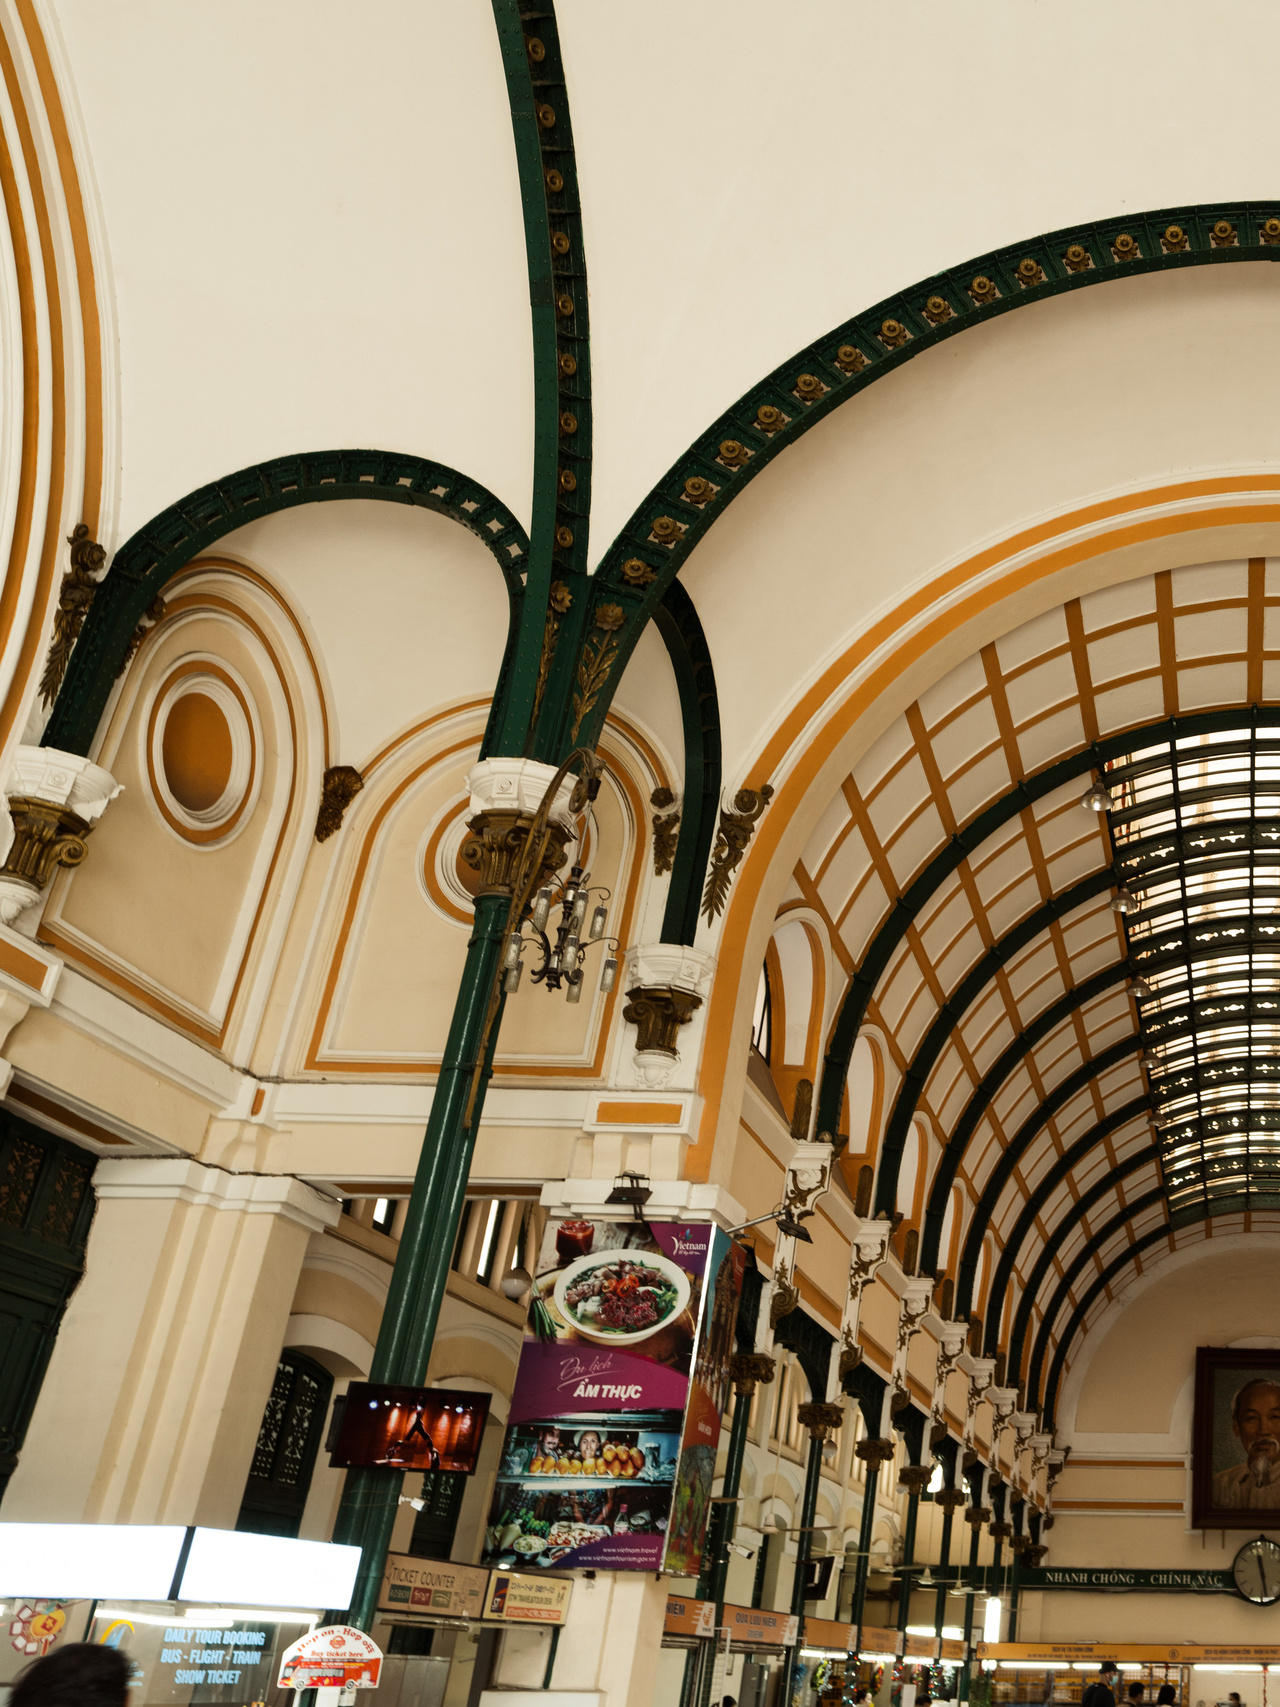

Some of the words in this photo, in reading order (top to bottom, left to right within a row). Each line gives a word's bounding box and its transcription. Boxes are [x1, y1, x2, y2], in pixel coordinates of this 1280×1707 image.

[671, 1236, 707, 1256] Vietnam
[560, 1356, 585, 1380] Du
[573, 1378, 600, 1398] ẨM
[601, 1384, 643, 1402] THỰC
[578, 1555, 656, 1563] www.vietnamtourism.gov.vn
[393, 1567, 419, 1583] TICKET
[421, 1571, 456, 1588] COUNTER
[1046, 1572, 1088, 1583] NHANH
[1092, 1571, 1135, 1584] CHÓNG
[1150, 1571, 1191, 1585] CHÍNH
[164, 1628, 193, 1644] DAILY
[196, 1629, 222, 1645] TOUR
[223, 1630, 266, 1646] BOOKING
[321, 1629, 335, 1637] on
[343, 1628, 362, 1641] Hop
[160, 1650, 183, 1664] BUS
[189, 1650, 225, 1665] FLIGHT
[232, 1651, 262, 1665] TRAIN
[174, 1670, 206, 1684] SHOW
[207, 1670, 242, 1685] TICKET
